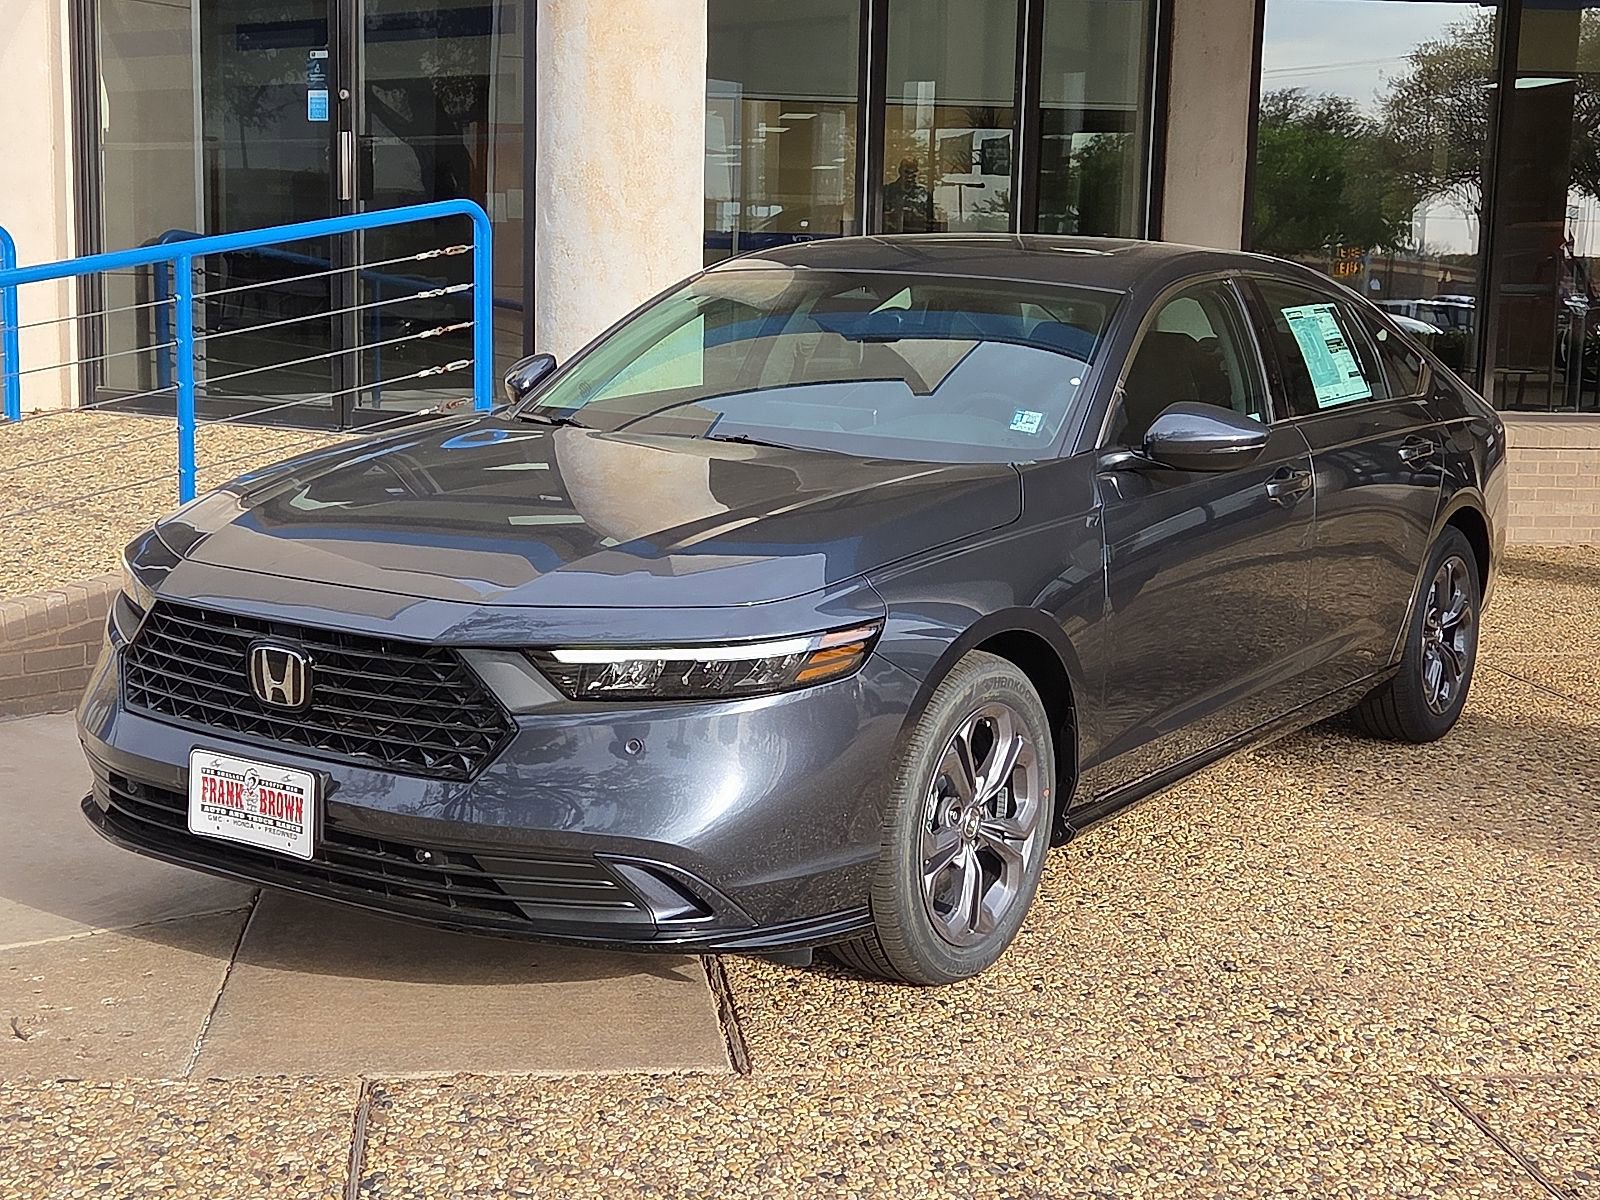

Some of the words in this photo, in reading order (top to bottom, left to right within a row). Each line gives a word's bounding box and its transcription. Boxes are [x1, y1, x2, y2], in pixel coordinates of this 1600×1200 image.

[201, 776, 244, 810] FRANK
[259, 788, 303, 824] BROWN
[203, 805, 227, 815] AUTO
[229, 810, 246, 819] AND
[247, 813, 274, 826] TRUCK
[275, 820, 302, 833] RANCH
[207, 814, 223, 822] GMC
[232, 819, 255, 830] HONDA
